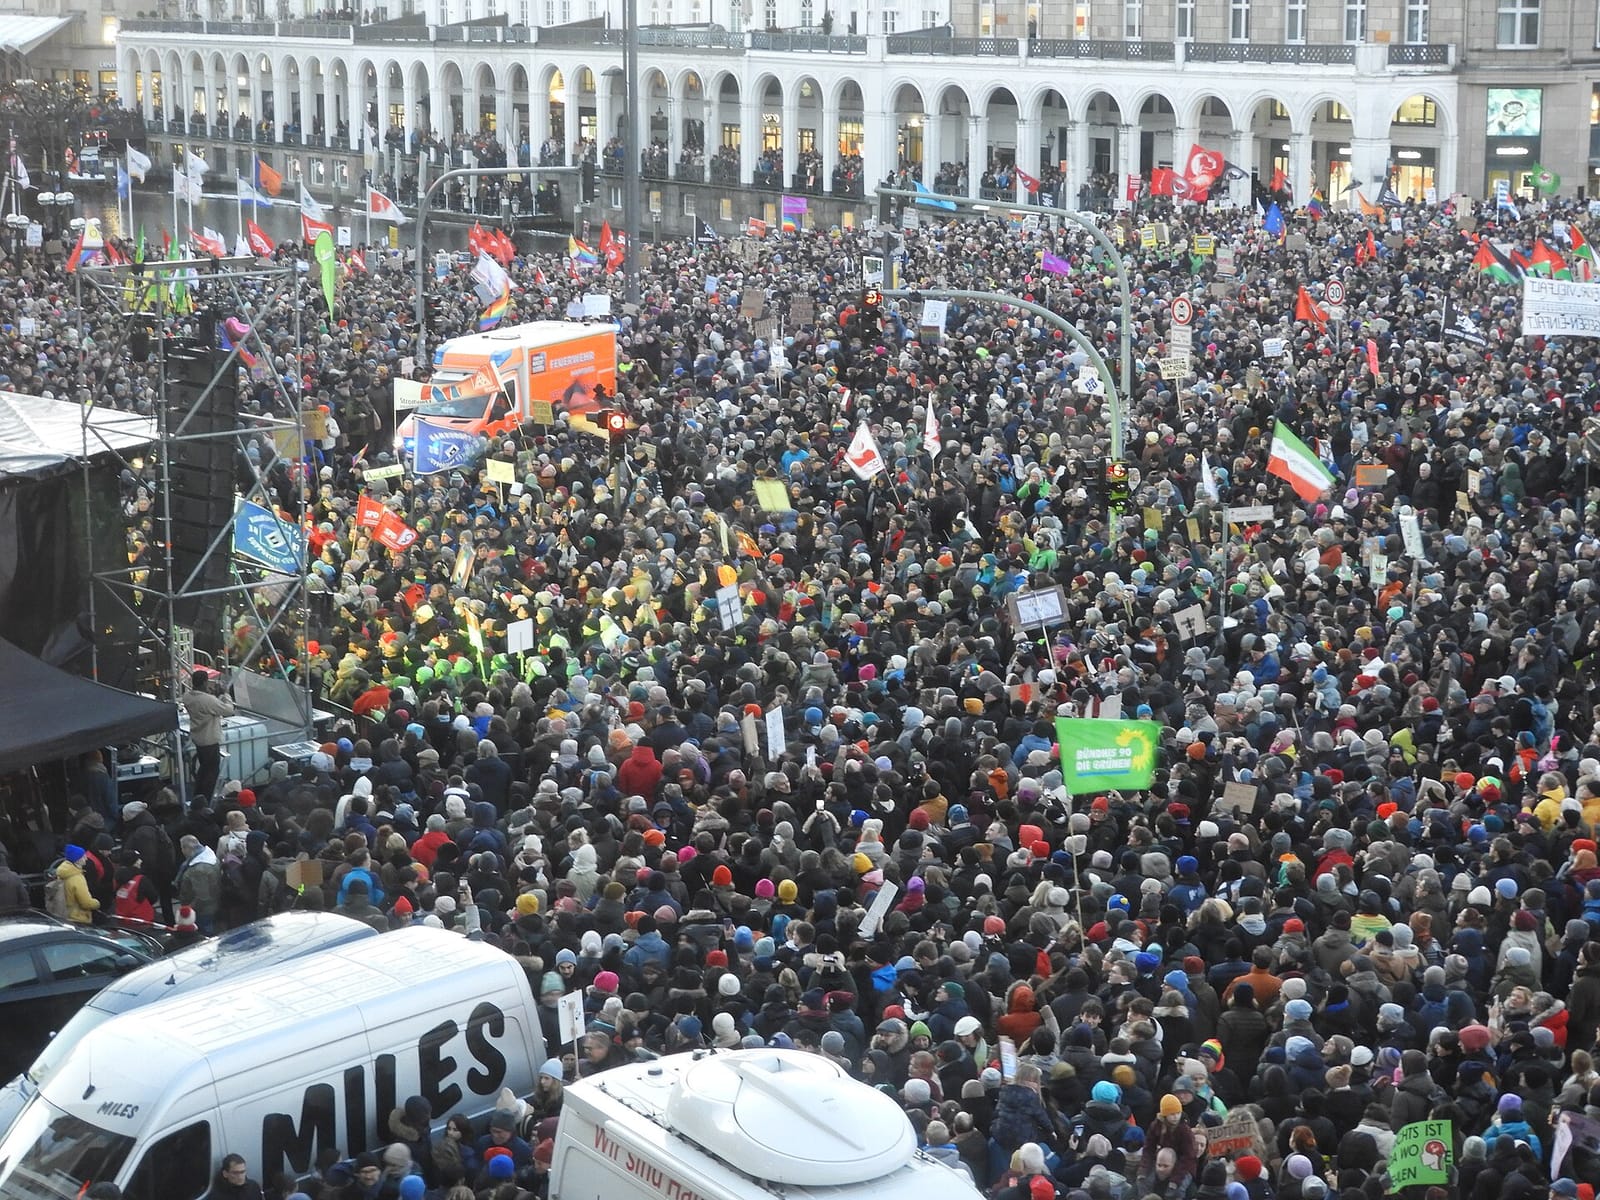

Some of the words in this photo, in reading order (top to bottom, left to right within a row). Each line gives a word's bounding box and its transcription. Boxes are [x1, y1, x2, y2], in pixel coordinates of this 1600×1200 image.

[1330, 287, 1341, 299] 30
[551, 351, 594, 369] FEUERWEHR
[1076, 747, 1116, 760] BÜNDNIS
[1118, 747, 1132, 757] 90
[1076, 760, 1090, 771] DIE
[1092, 758, 1132, 769] GRÜNEN
[262, 1001, 507, 1188] MILES
[97, 1101, 139, 1119] MILES
[1425, 1123, 1443, 1136] IST
[594, 1124, 620, 1160] Wir
[1401, 1144, 1419, 1160] WO
